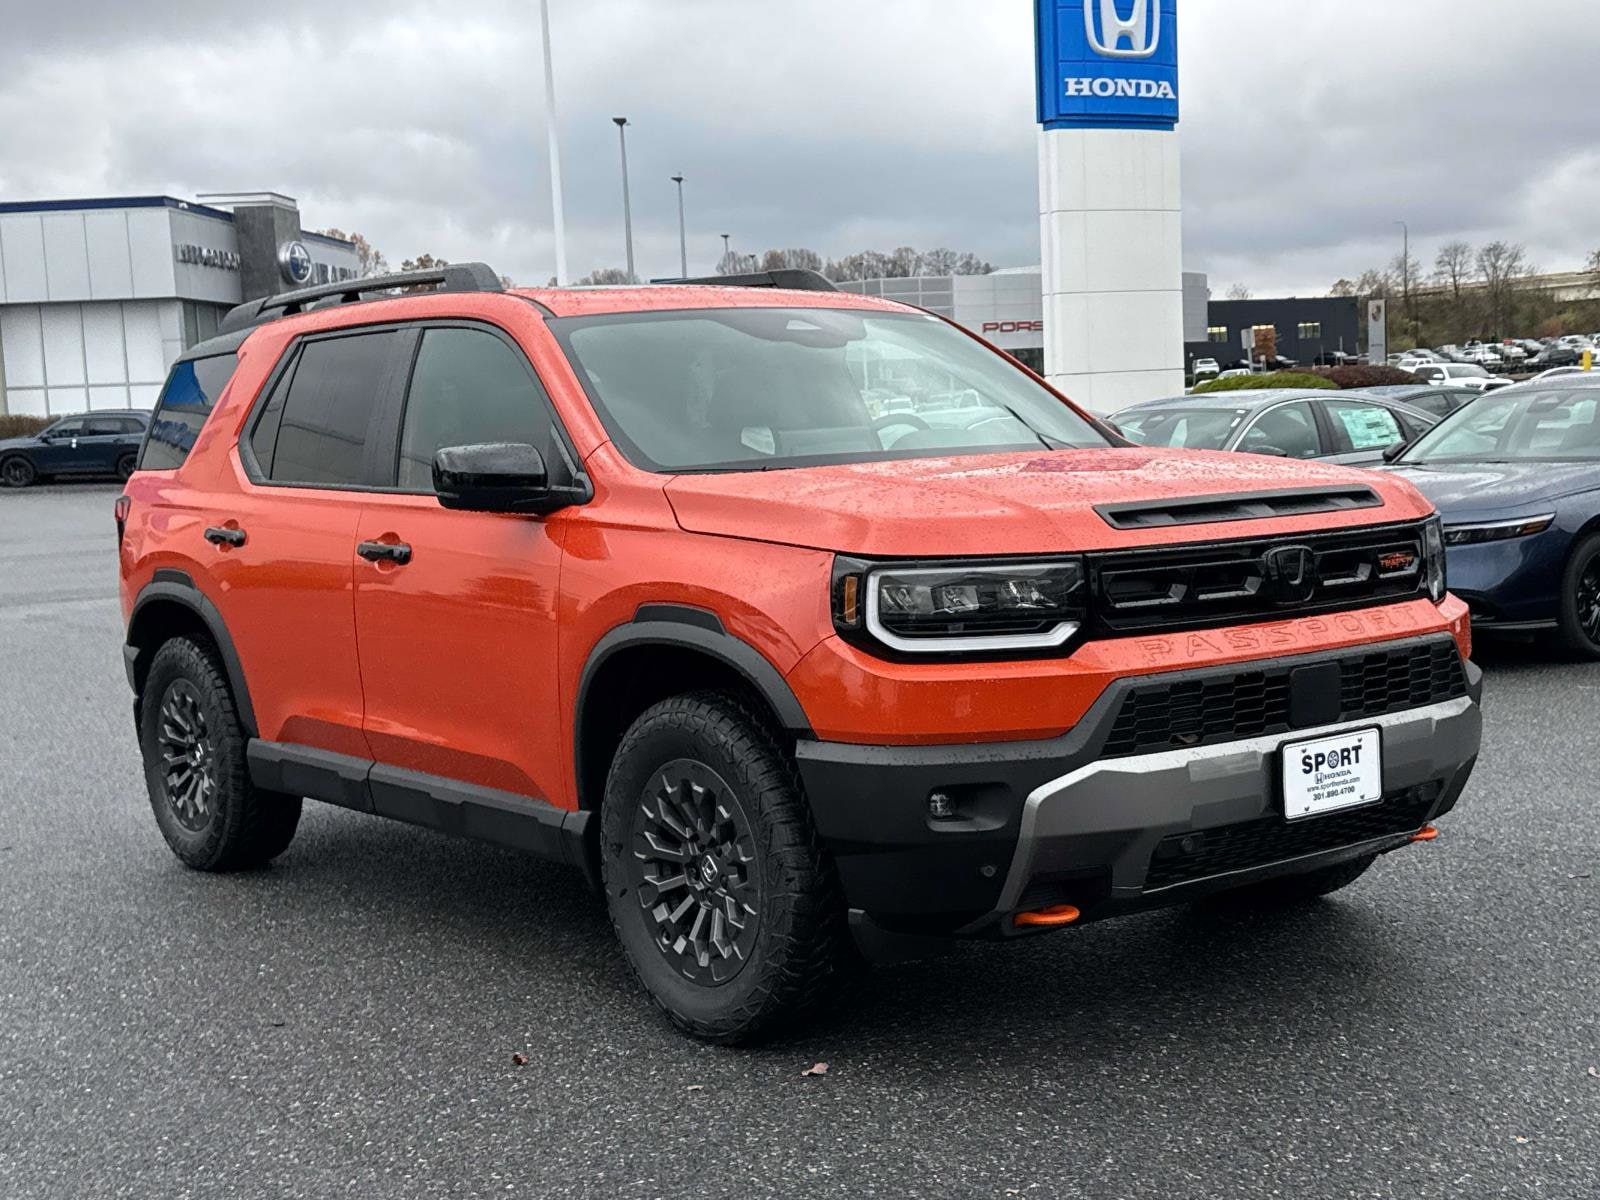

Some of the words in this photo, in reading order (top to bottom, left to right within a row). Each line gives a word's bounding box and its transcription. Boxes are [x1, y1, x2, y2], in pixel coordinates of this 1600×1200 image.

[1064, 77, 1176, 99] HONDA
[1135, 604, 1420, 662] PASSPORT
[1301, 744, 1362, 774] SPORT
[1324, 769, 1352, 780] HONDA
[1307, 776, 1361, 793] www.sporthonda.com
[1313, 785, 1355, 801] 301.890.4700
